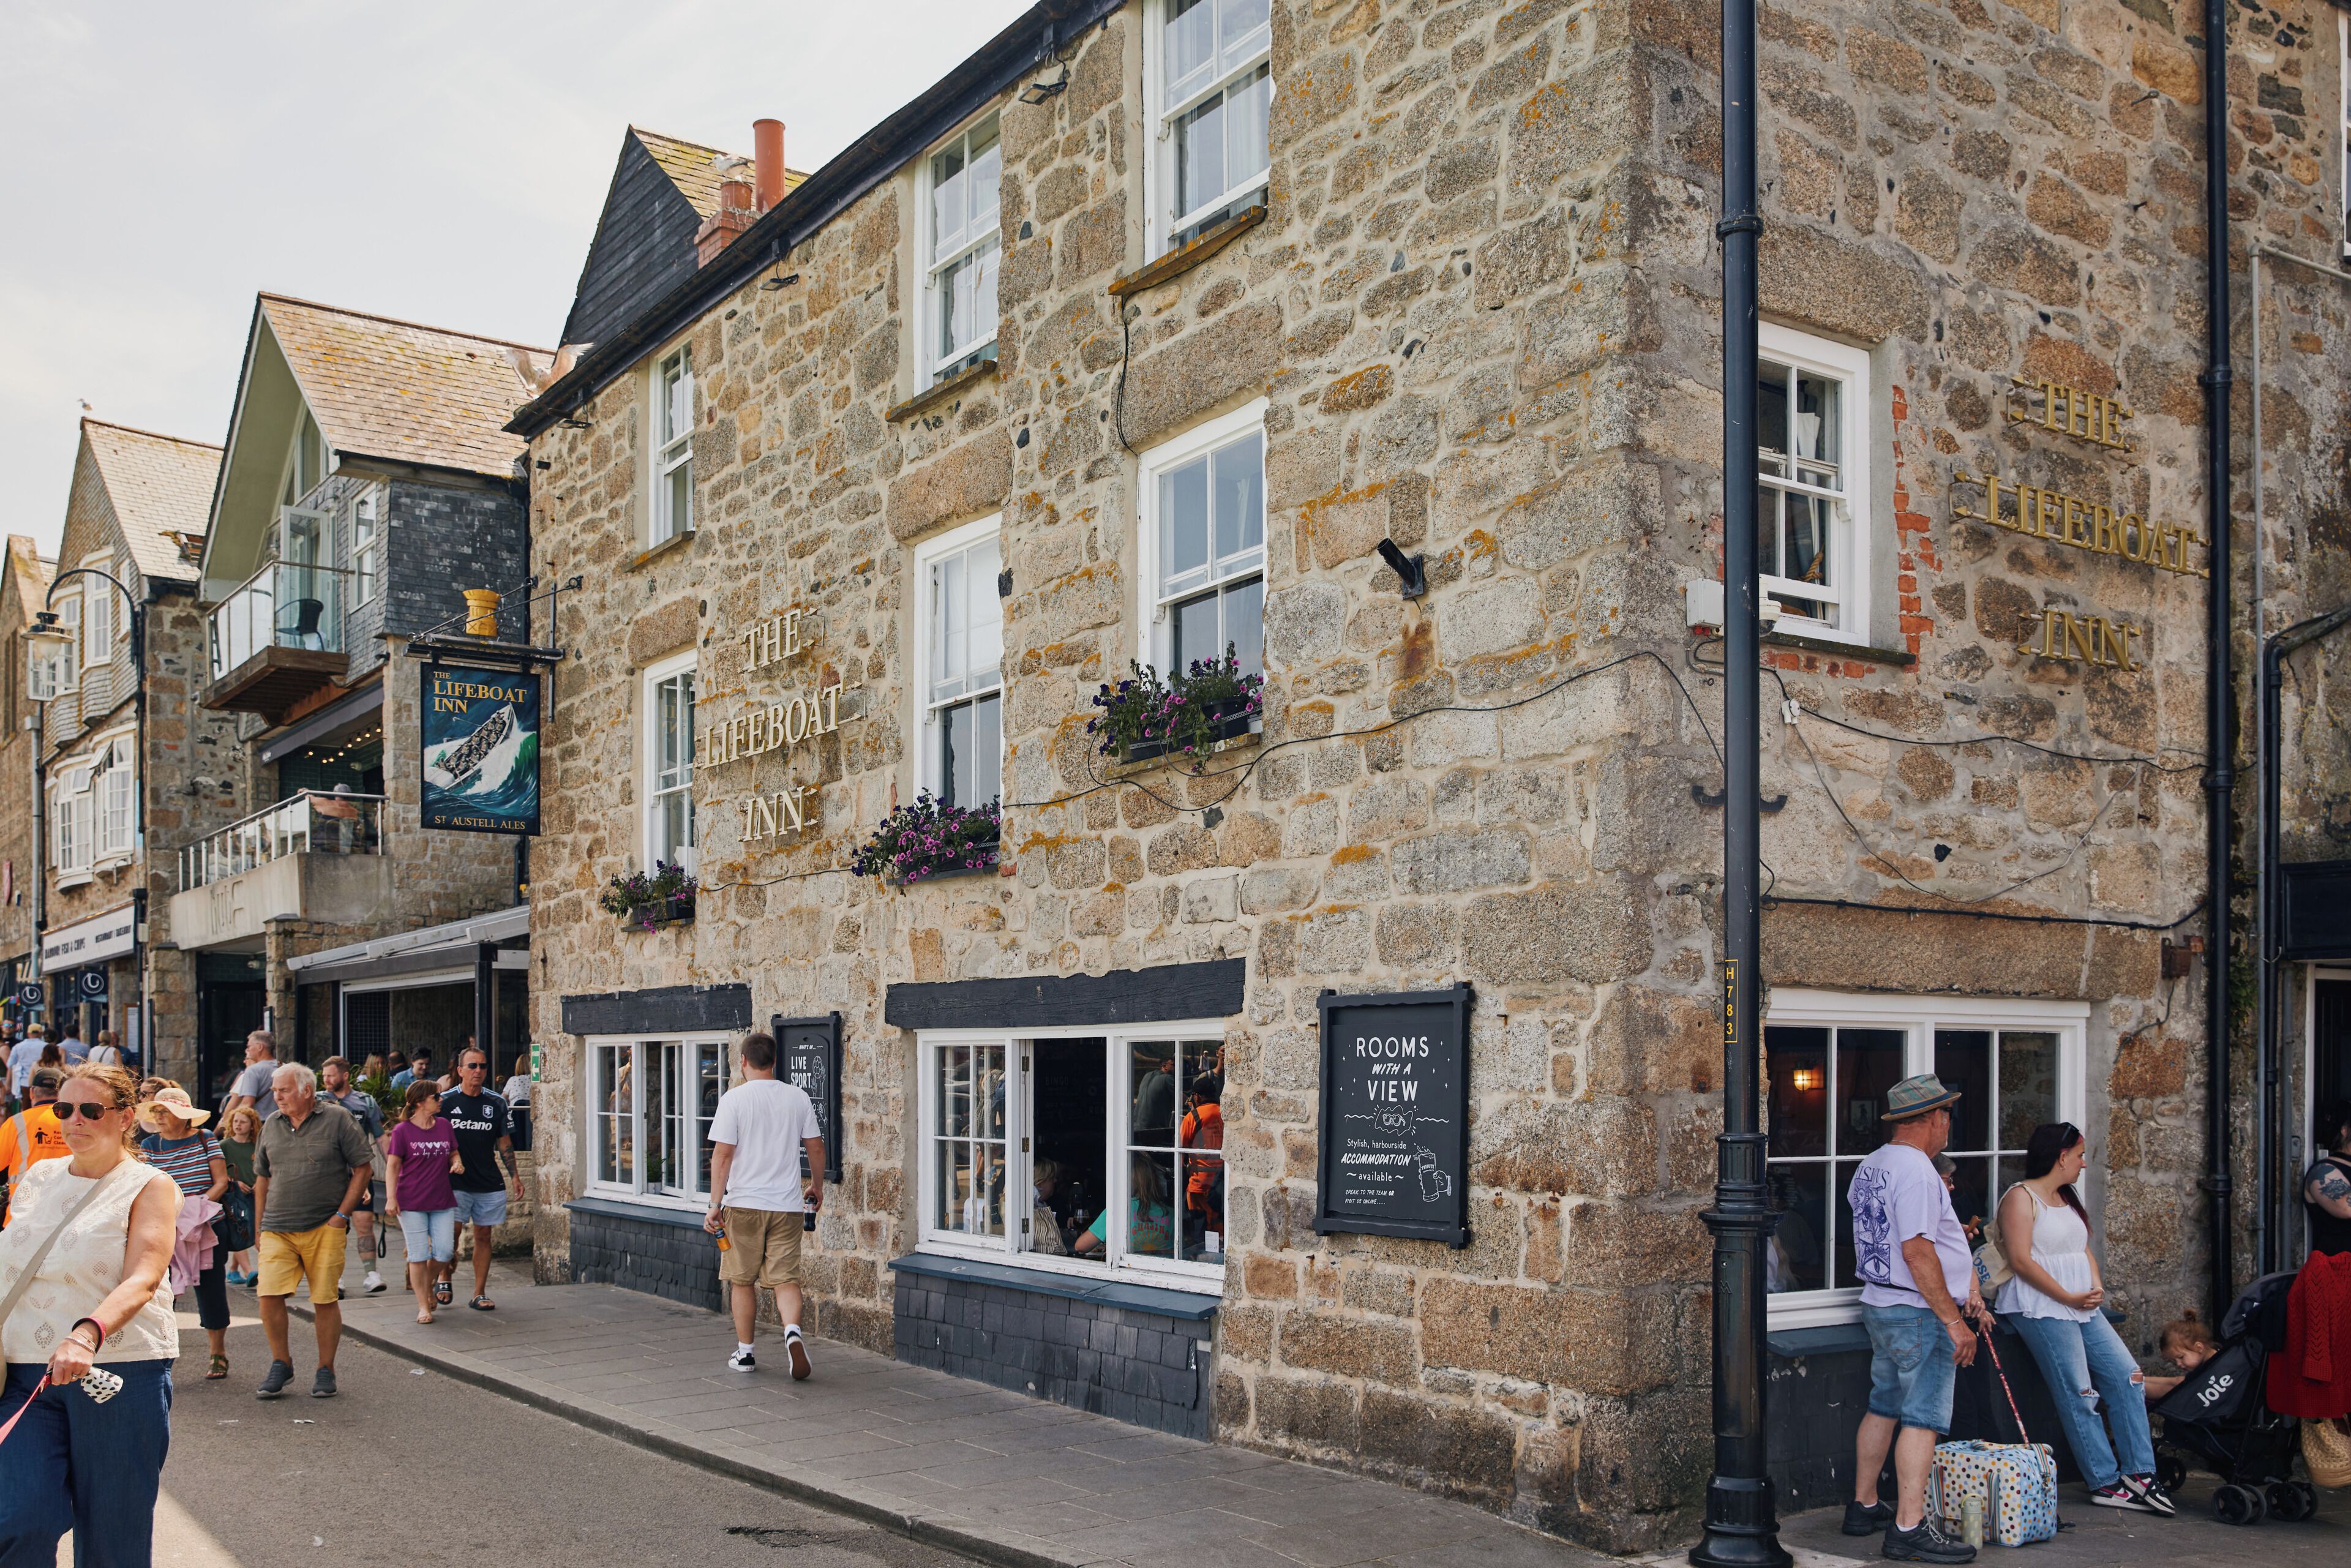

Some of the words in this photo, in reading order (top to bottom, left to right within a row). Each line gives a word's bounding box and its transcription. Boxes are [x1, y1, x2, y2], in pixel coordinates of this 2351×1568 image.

[2034, 376, 2124, 449] THE
[1984, 473, 2197, 575] LIFEBOAT
[743, 609, 804, 672] THE
[2041, 607, 2132, 672] INN
[433, 671, 451, 680] THE
[433, 680, 527, 703] LIFEBOAT
[433, 697, 468, 714] INN
[703, 679, 846, 770] LIFEBOAT
[452, 817, 497, 828] AUSTELL
[500, 820, 525, 830] ALES
[743, 786, 805, 842] INN
[1356, 1036, 1429, 1058] ROOMS
[791, 1056, 807, 1070] LIVE
[1371, 1063, 1401, 1075] WITH
[1403, 1062, 1412, 1075] A
[790, 1071, 812, 1089] SPORT
[1367, 1079, 1419, 1102] VIEW
[451, 1119, 492, 1131] Betano
[1347, 1138, 1370, 1149] Stylish,
[1372, 1139, 1406, 1150] harbourside
[1341, 1153, 1411, 1166] ACCOMMODATION
[1359, 1171, 1392, 1182] available
[2197, 1375, 2233, 1408] Joie
